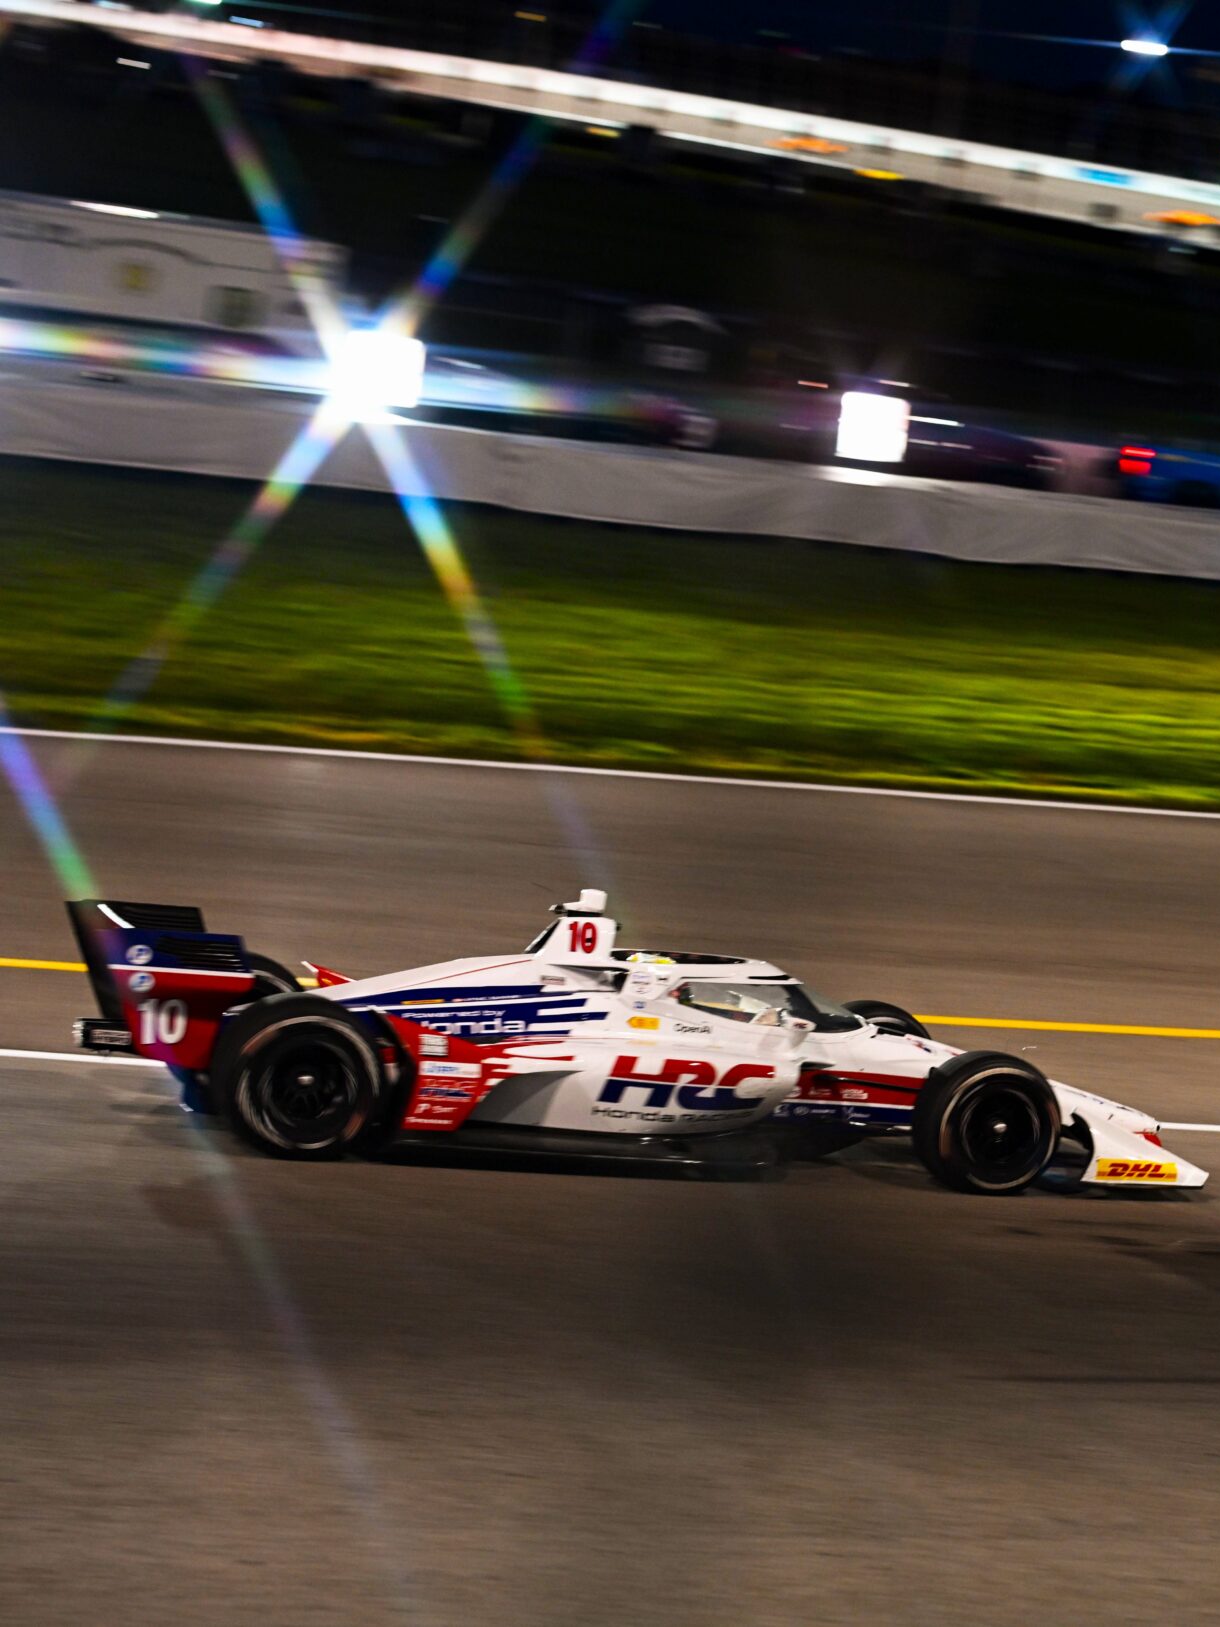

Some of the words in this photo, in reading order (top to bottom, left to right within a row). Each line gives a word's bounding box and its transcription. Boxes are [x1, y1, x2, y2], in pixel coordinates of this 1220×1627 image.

[567, 920, 598, 954] 10
[137, 998, 189, 1045] 10
[401, 1009, 481, 1019] Powered
[482, 1009, 506, 1018] by
[672, 1022, 713, 1034] OpenAI
[596, 1054, 777, 1111] HRC
[590, 1105, 676, 1123] Honda
[1107, 1162, 1166, 1179] DHL
